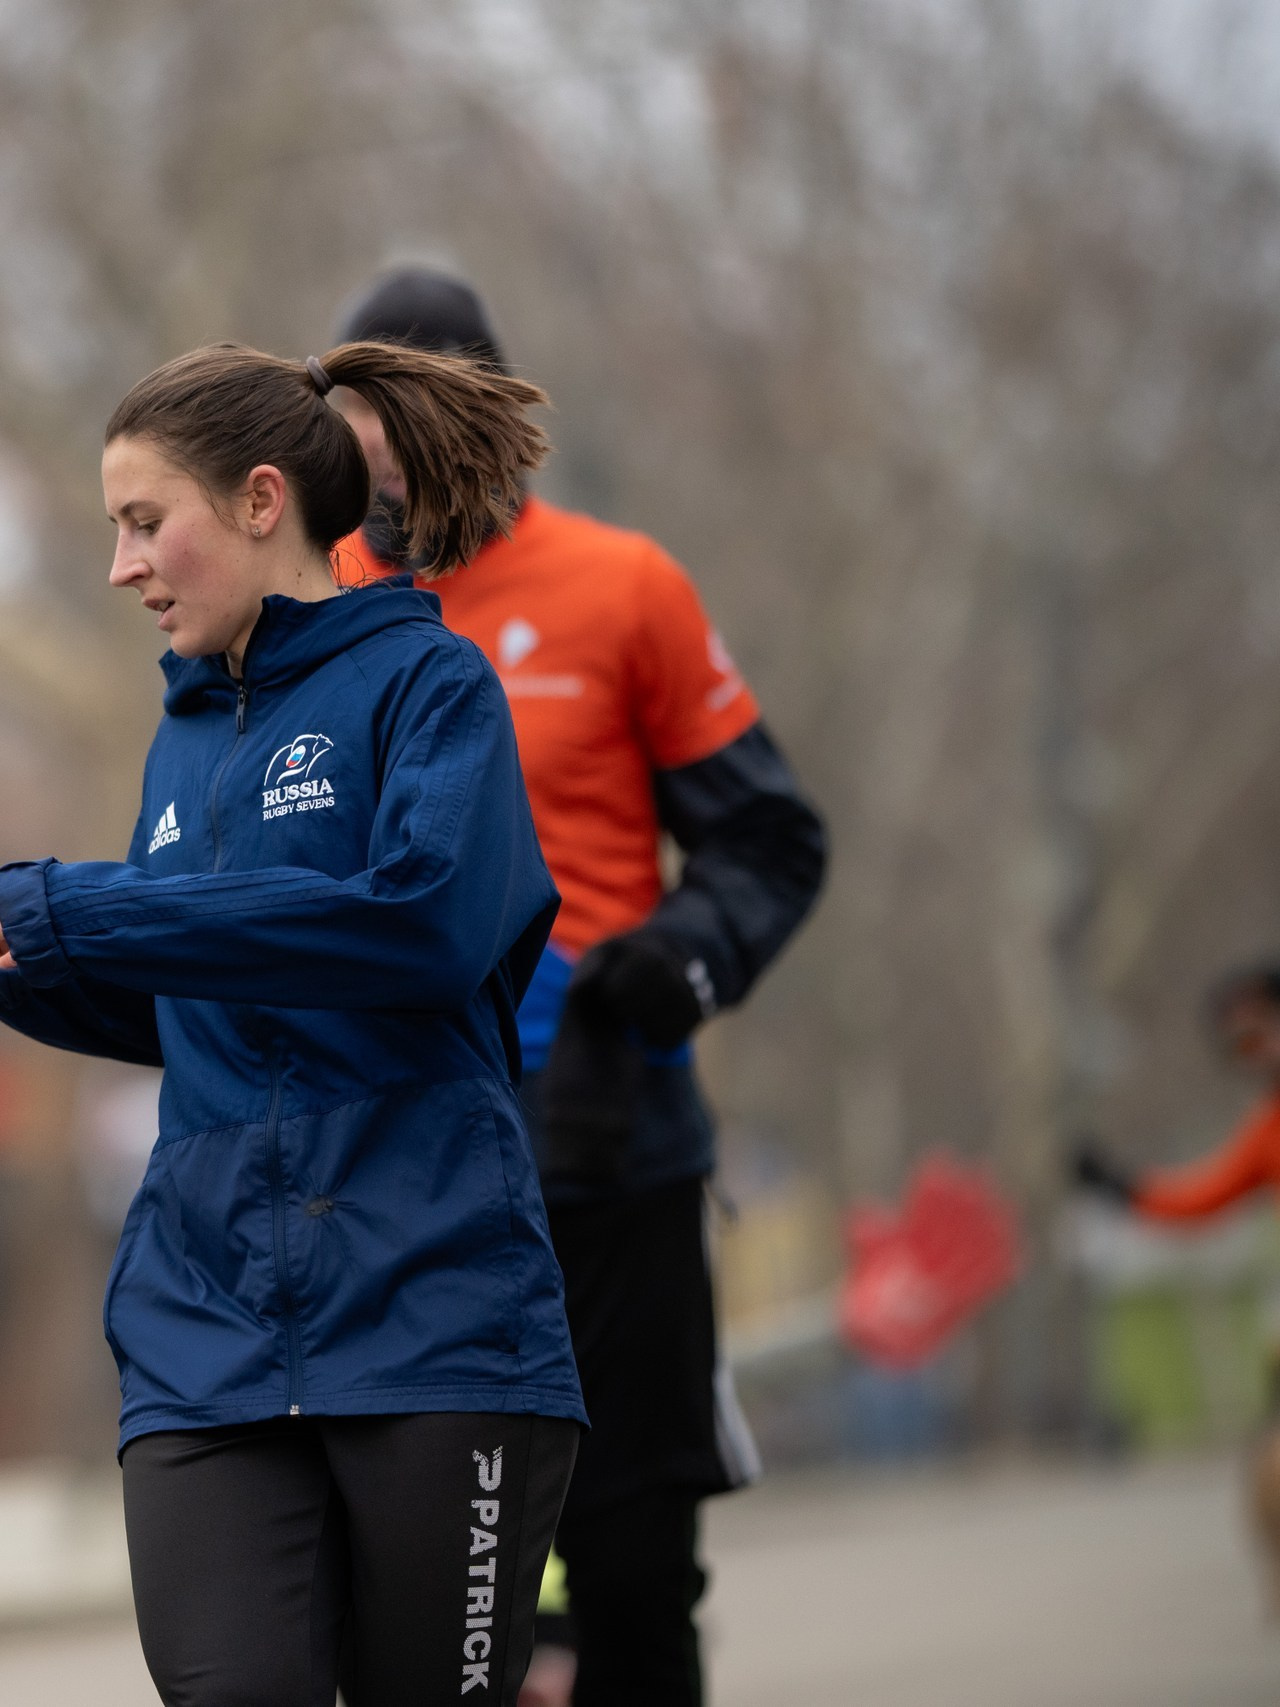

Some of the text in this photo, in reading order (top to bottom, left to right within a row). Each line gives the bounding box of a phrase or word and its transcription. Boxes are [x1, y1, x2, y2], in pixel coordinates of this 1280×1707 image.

[262, 778, 334, 808] RUSSIA
[262, 797, 335, 821] RUGBY SEVENS
[148, 827, 181, 854] adidas
[461, 1500, 500, 1695] PATRICK
